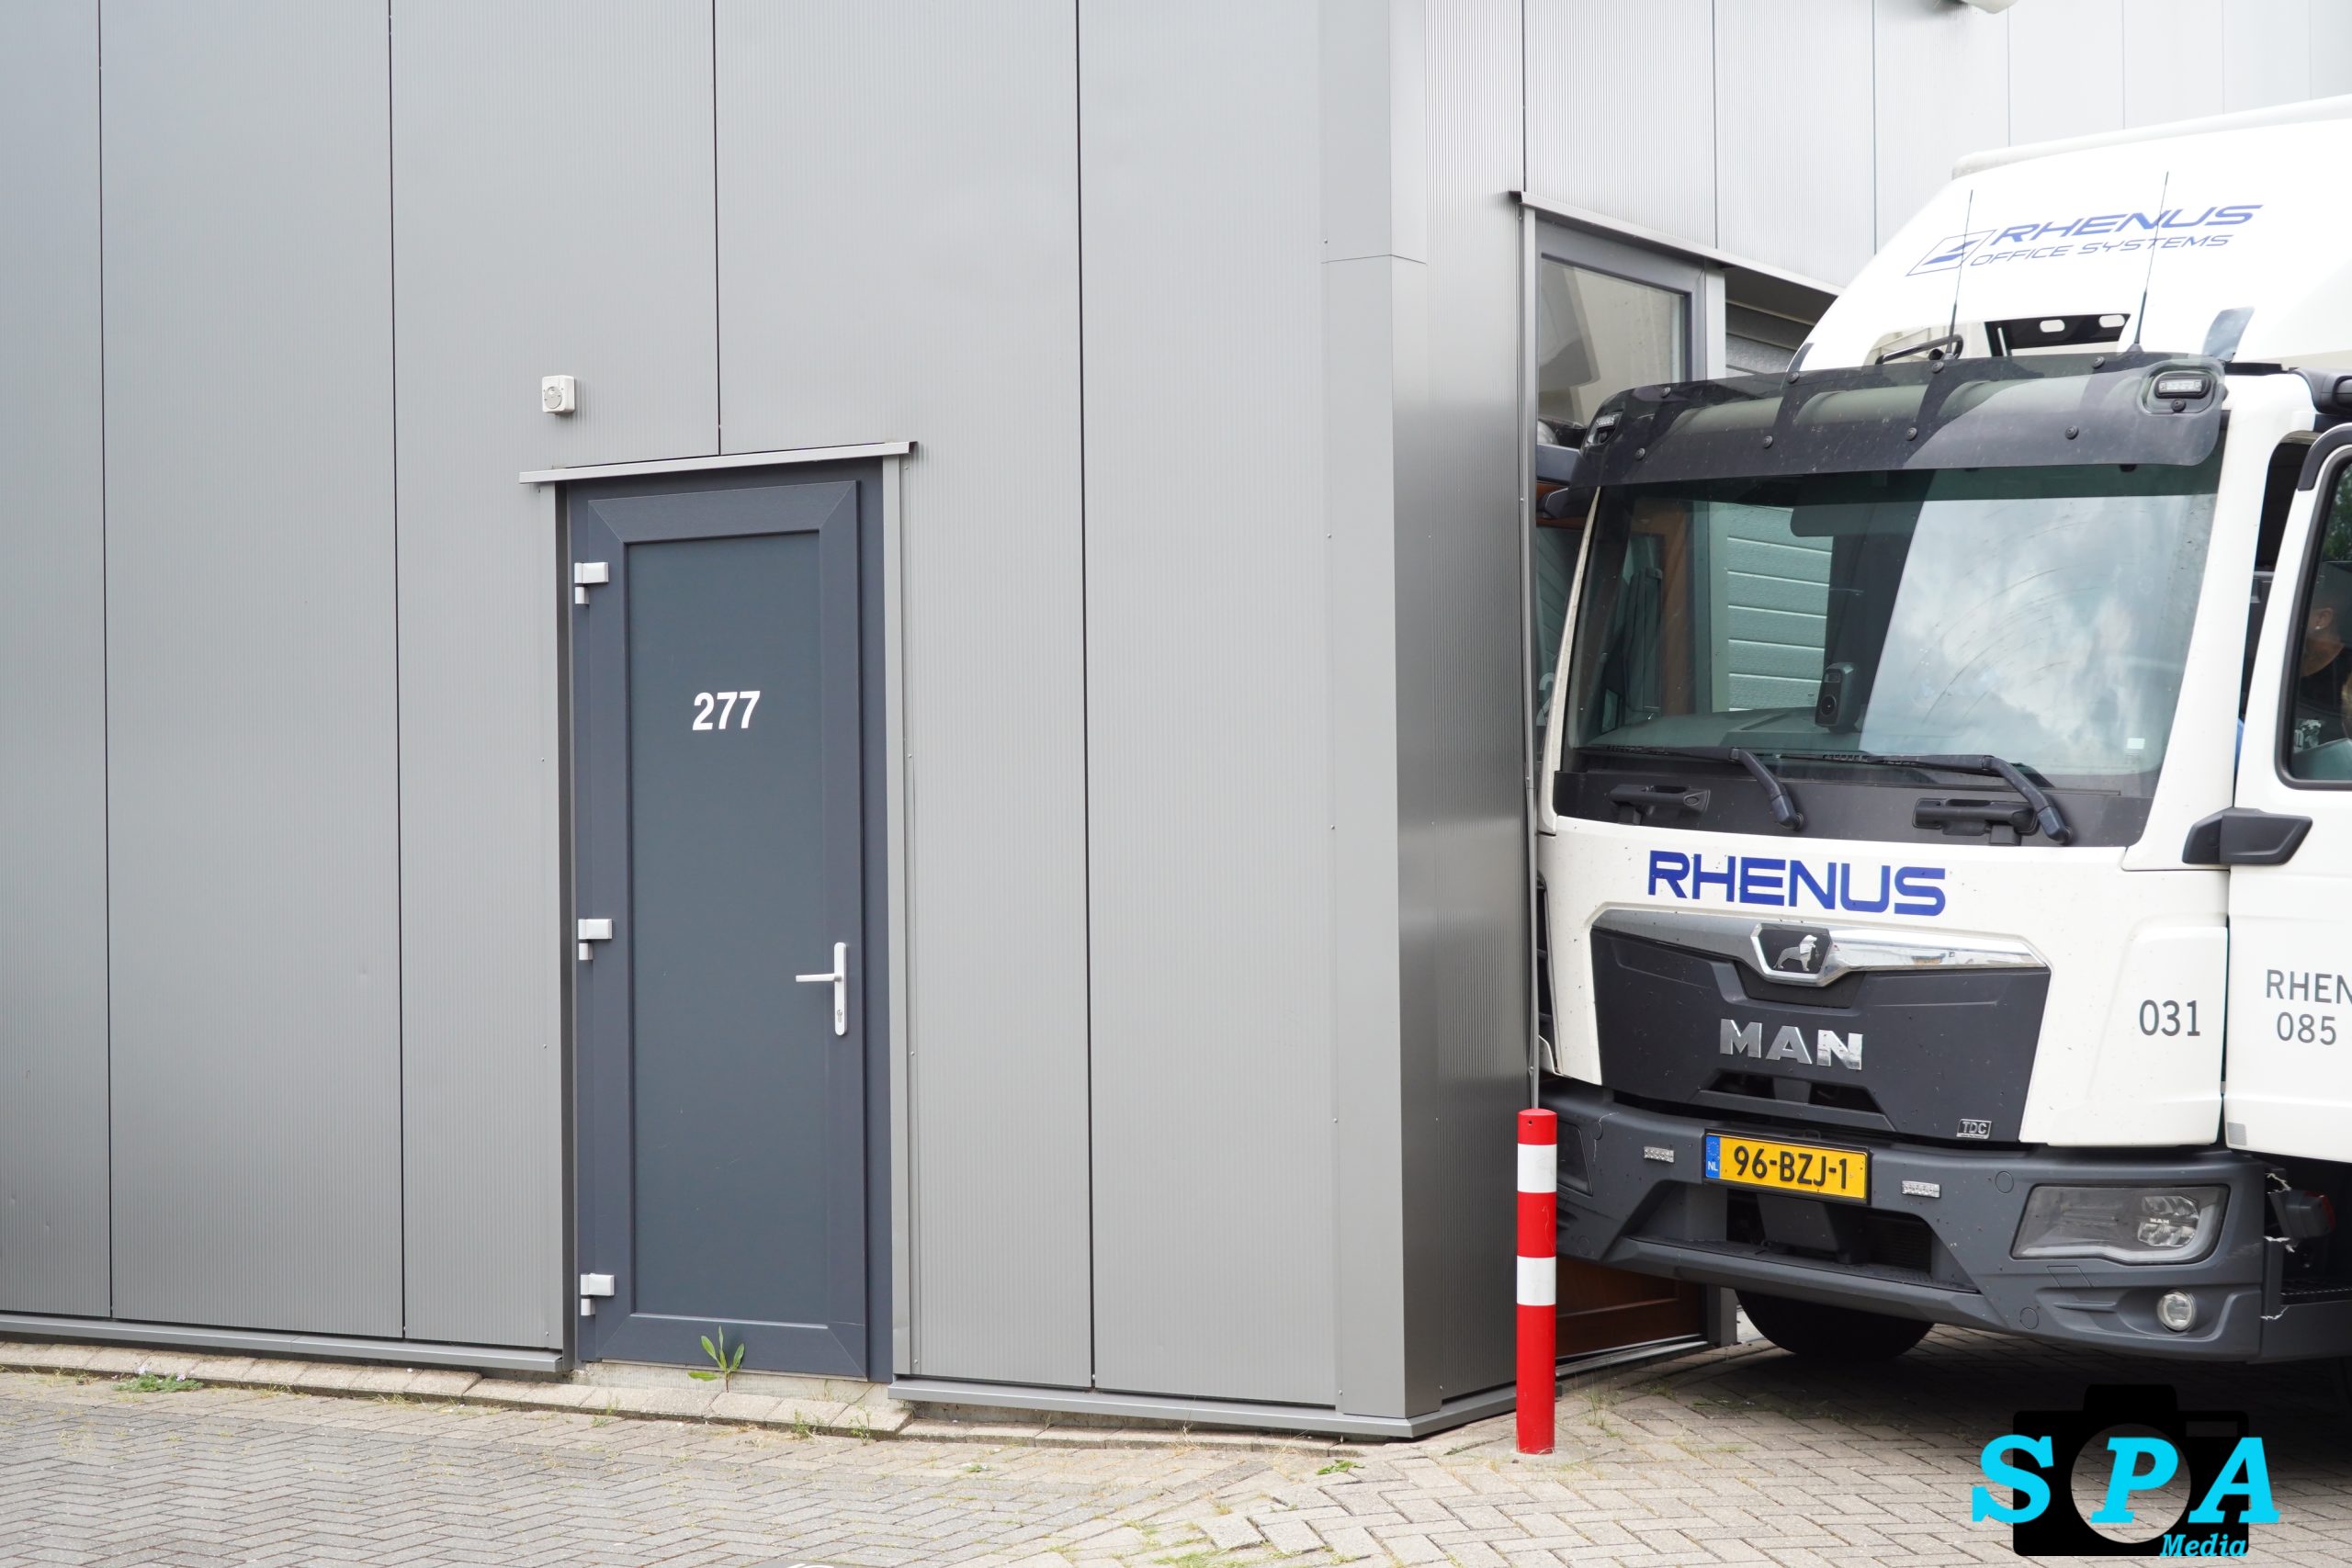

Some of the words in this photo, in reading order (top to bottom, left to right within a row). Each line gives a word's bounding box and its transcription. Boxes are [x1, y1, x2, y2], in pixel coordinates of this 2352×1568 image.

[1989, 204, 2264, 246] RHENUS
[1970, 244, 2074, 266] OFFICE
[2077, 234, 2234, 255] SYSTEMS
[692, 690, 761, 731] 277
[1648, 850, 1946, 917] RHENUS
[2266, 968, 2352, 1005] RHEN
[2139, 998, 2201, 1037] 031
[2277, 1011, 2337, 1046] 085
[1719, 1018, 1862, 1070] MAN
[1962, 1121, 1987, 1134] TDC
[1707, 1160, 1719, 1172] NL
[1734, 1145, 1848, 1190] 96-BZJ-1
